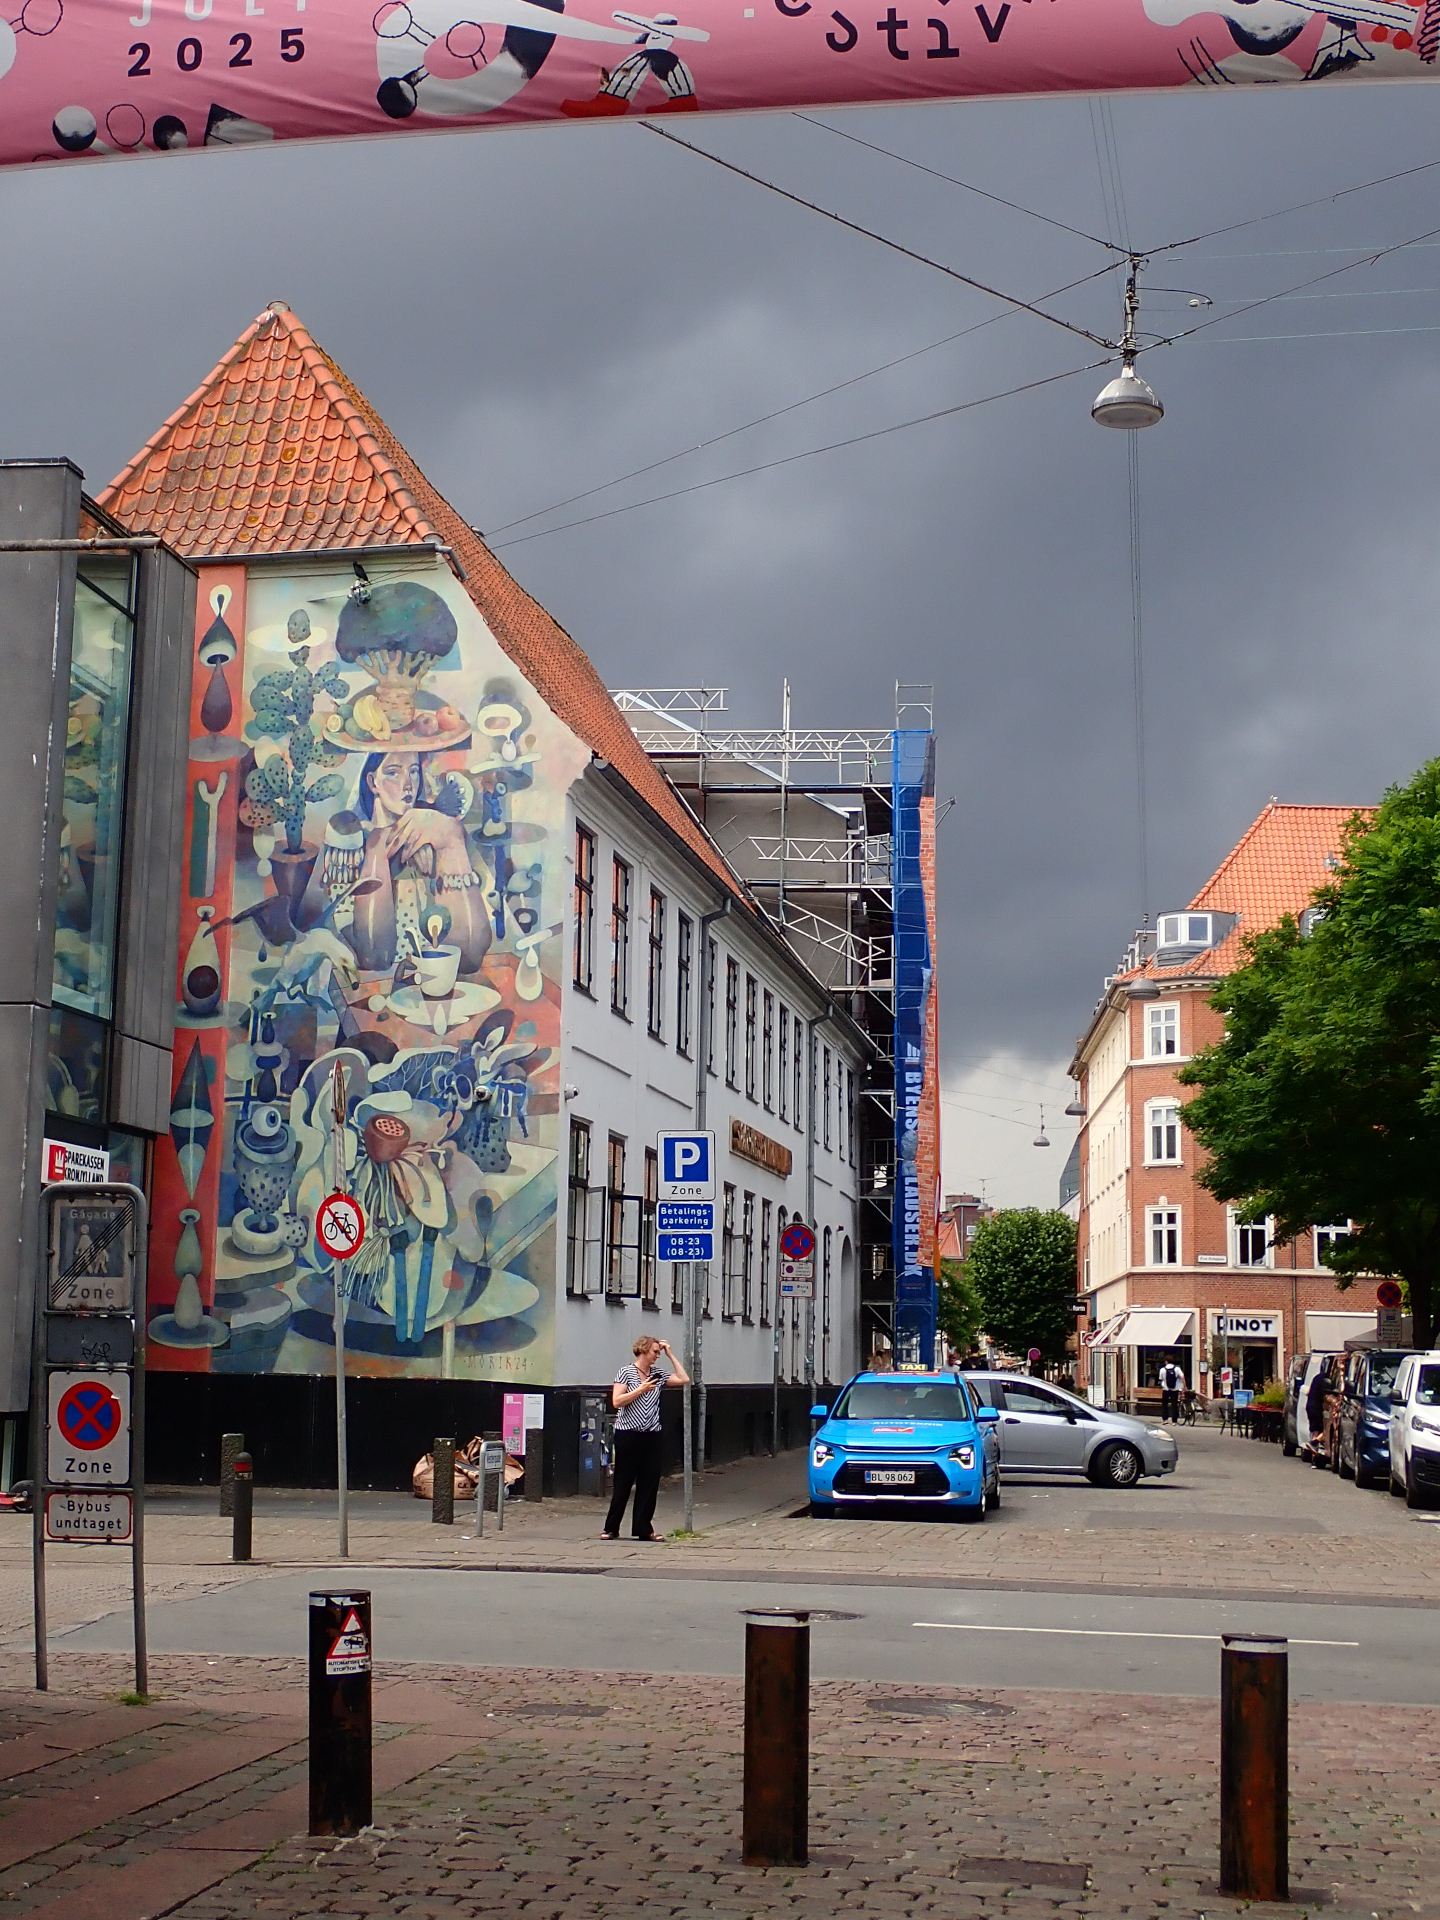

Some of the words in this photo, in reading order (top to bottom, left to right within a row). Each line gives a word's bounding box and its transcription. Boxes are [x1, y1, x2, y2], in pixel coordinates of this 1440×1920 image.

[127, 27, 306, 78] 2025
[904, 1071, 923, 1130] BYENS
[64, 1150, 105, 1171] SPAREKASSEN
[674, 1141, 701, 1178] P
[671, 1185, 702, 1195] Zone
[70, 1207, 116, 1221] Gågade
[660, 1207, 711, 1217] Betalings-
[662, 1217, 709, 1226] parkering
[670, 1237, 700, 1246] 08-23
[666, 1246, 704, 1256] (08-23)
[67, 1284, 115, 1299] Zone
[1216, 1316, 1273, 1334] PINOT
[65, 1458, 112, 1474] Zone
[871, 1473, 883, 1482] BL
[885, 1473, 896, 1482] 98
[897, 1473, 914, 1482] 062
[67, 1500, 111, 1514] Bybus
[56, 1517, 122, 1531] undtaget
